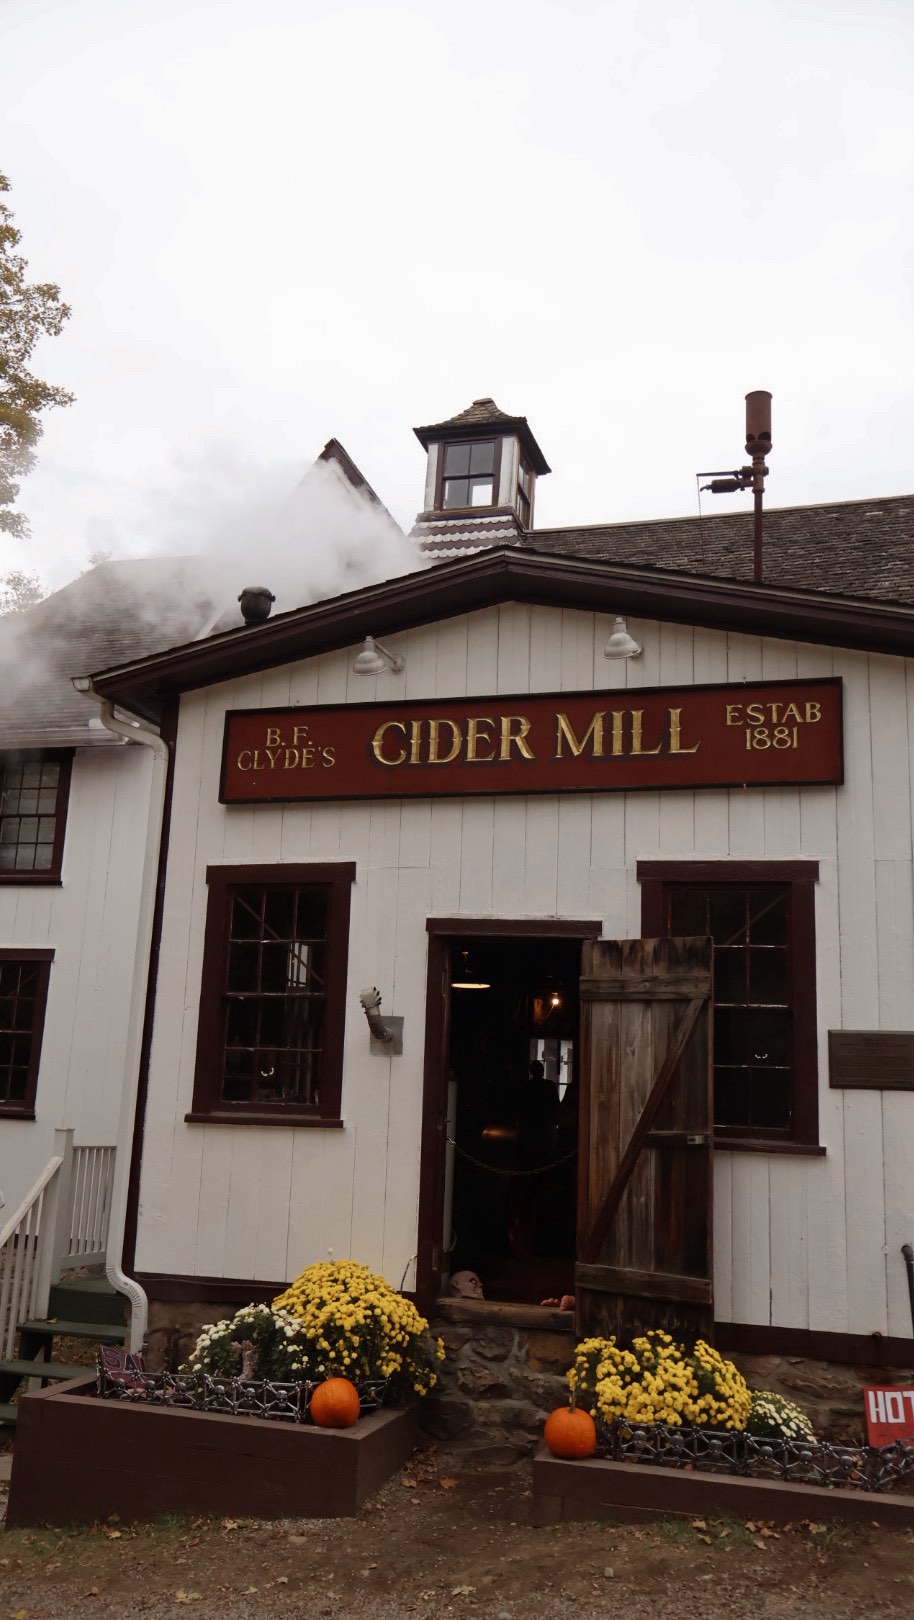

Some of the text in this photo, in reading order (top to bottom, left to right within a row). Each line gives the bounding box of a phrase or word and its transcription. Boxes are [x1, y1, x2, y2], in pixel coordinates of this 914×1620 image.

[726, 702, 822, 726] ESTAB
[265, 725, 313, 747] B. F.
[371, 708, 701, 766] CIDER MILL
[745, 726, 798, 750] 1881
[237, 747, 336, 771] CLYDE'S
